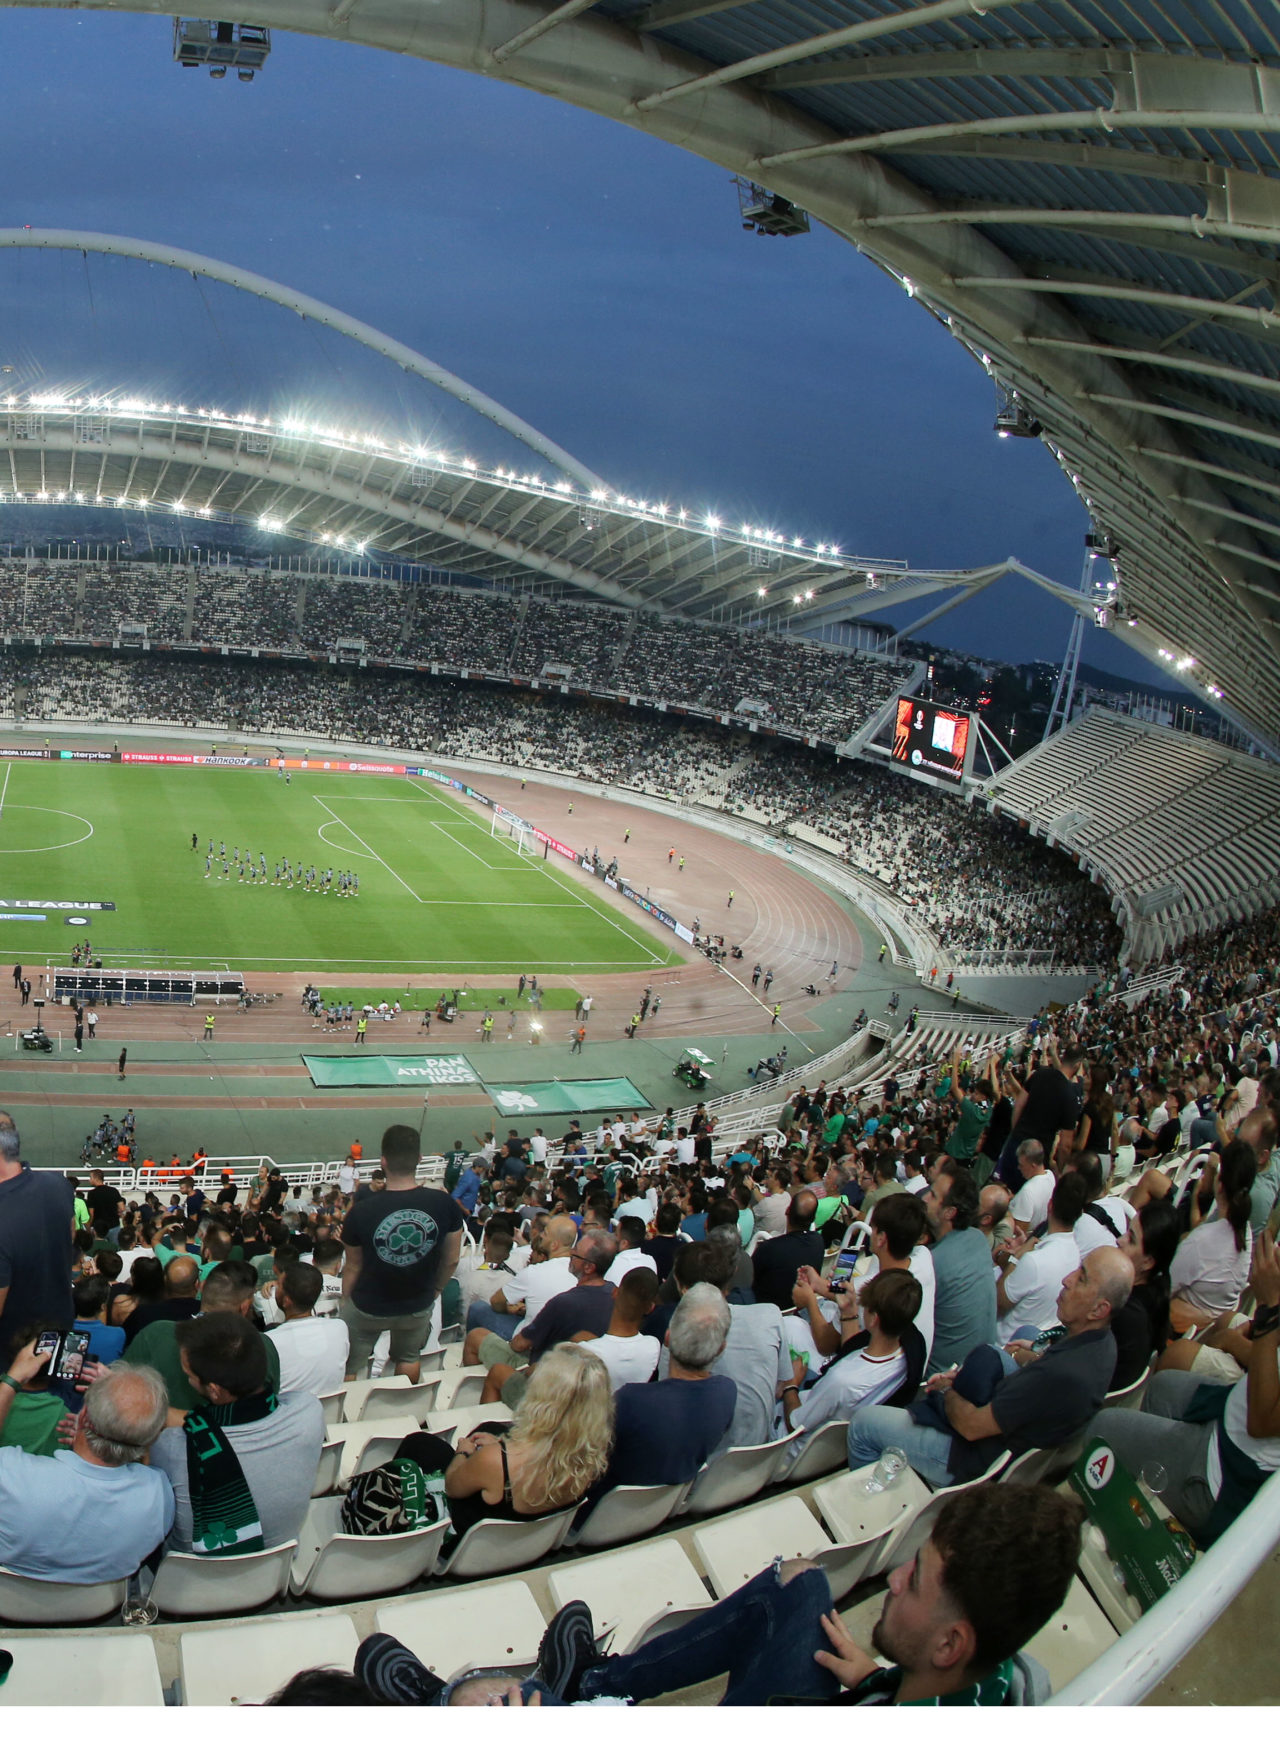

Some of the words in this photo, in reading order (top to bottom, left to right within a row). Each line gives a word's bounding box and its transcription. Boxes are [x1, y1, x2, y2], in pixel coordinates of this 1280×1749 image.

[357, 763, 394, 773] Swissquote
[15, 900, 103, 910] LEAGUE
[425, 1057, 466, 1068] PAN
[397, 1066, 471, 1076] ATHINA
[428, 1074, 476, 1084] IKOS
